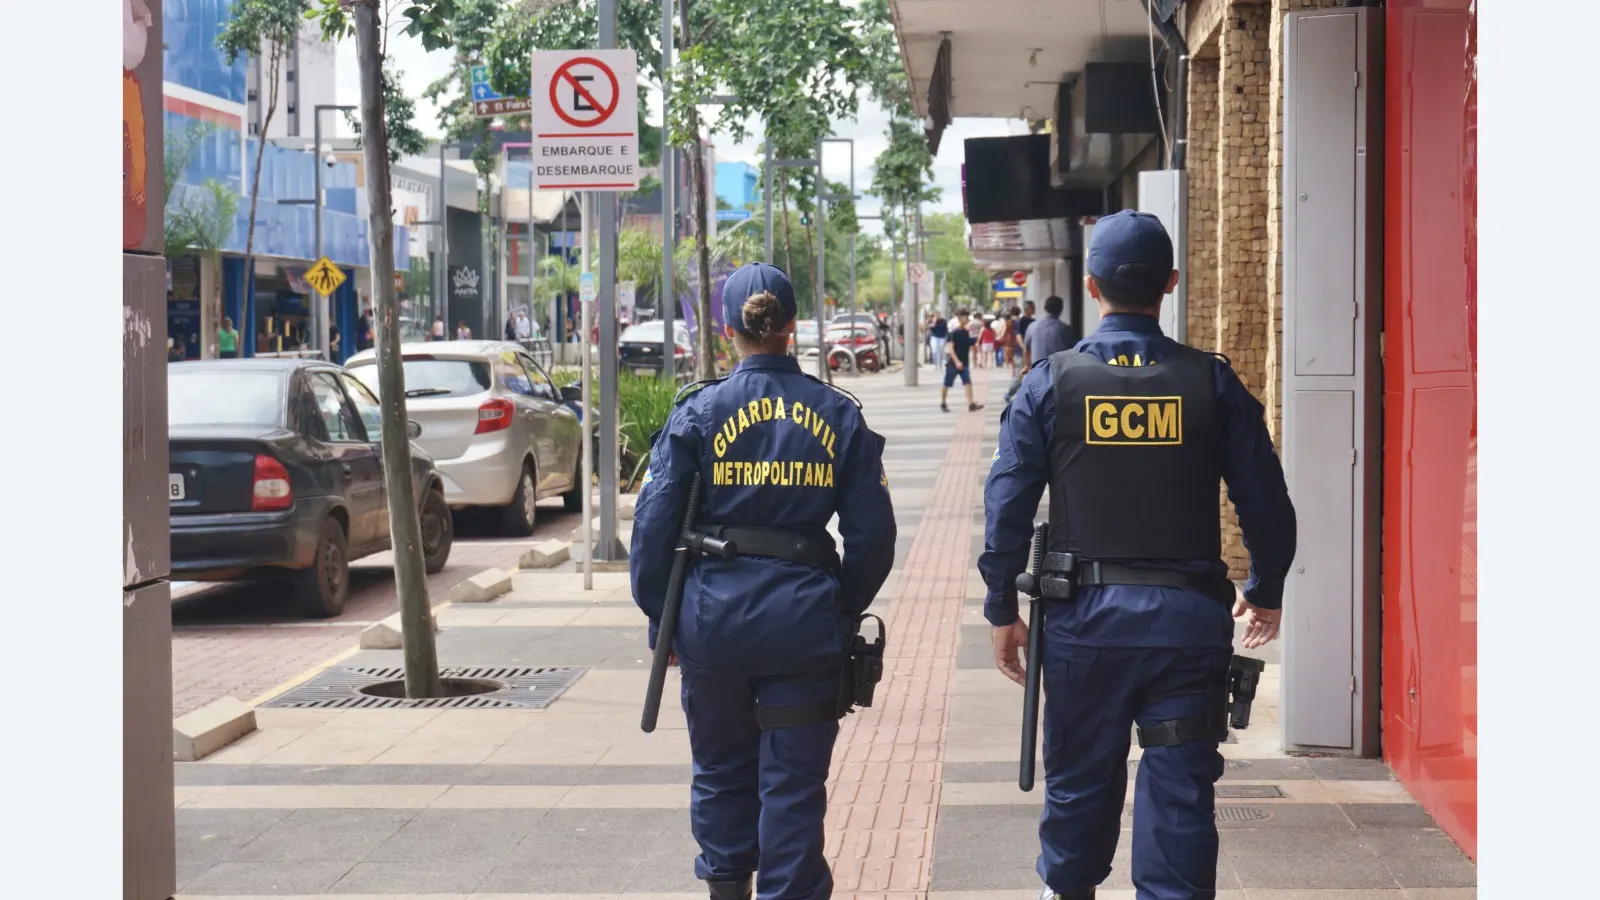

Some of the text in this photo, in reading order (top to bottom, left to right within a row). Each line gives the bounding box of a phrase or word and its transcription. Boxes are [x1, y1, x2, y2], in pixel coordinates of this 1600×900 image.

[542, 145, 629, 156] EMBARQUE E
[537, 165, 634, 176] DESEMBARQUE
[713, 397, 836, 459] GUARDA CIVIL
[1092, 402, 1177, 439] GCM
[713, 461, 834, 487] METROPOLITANA
